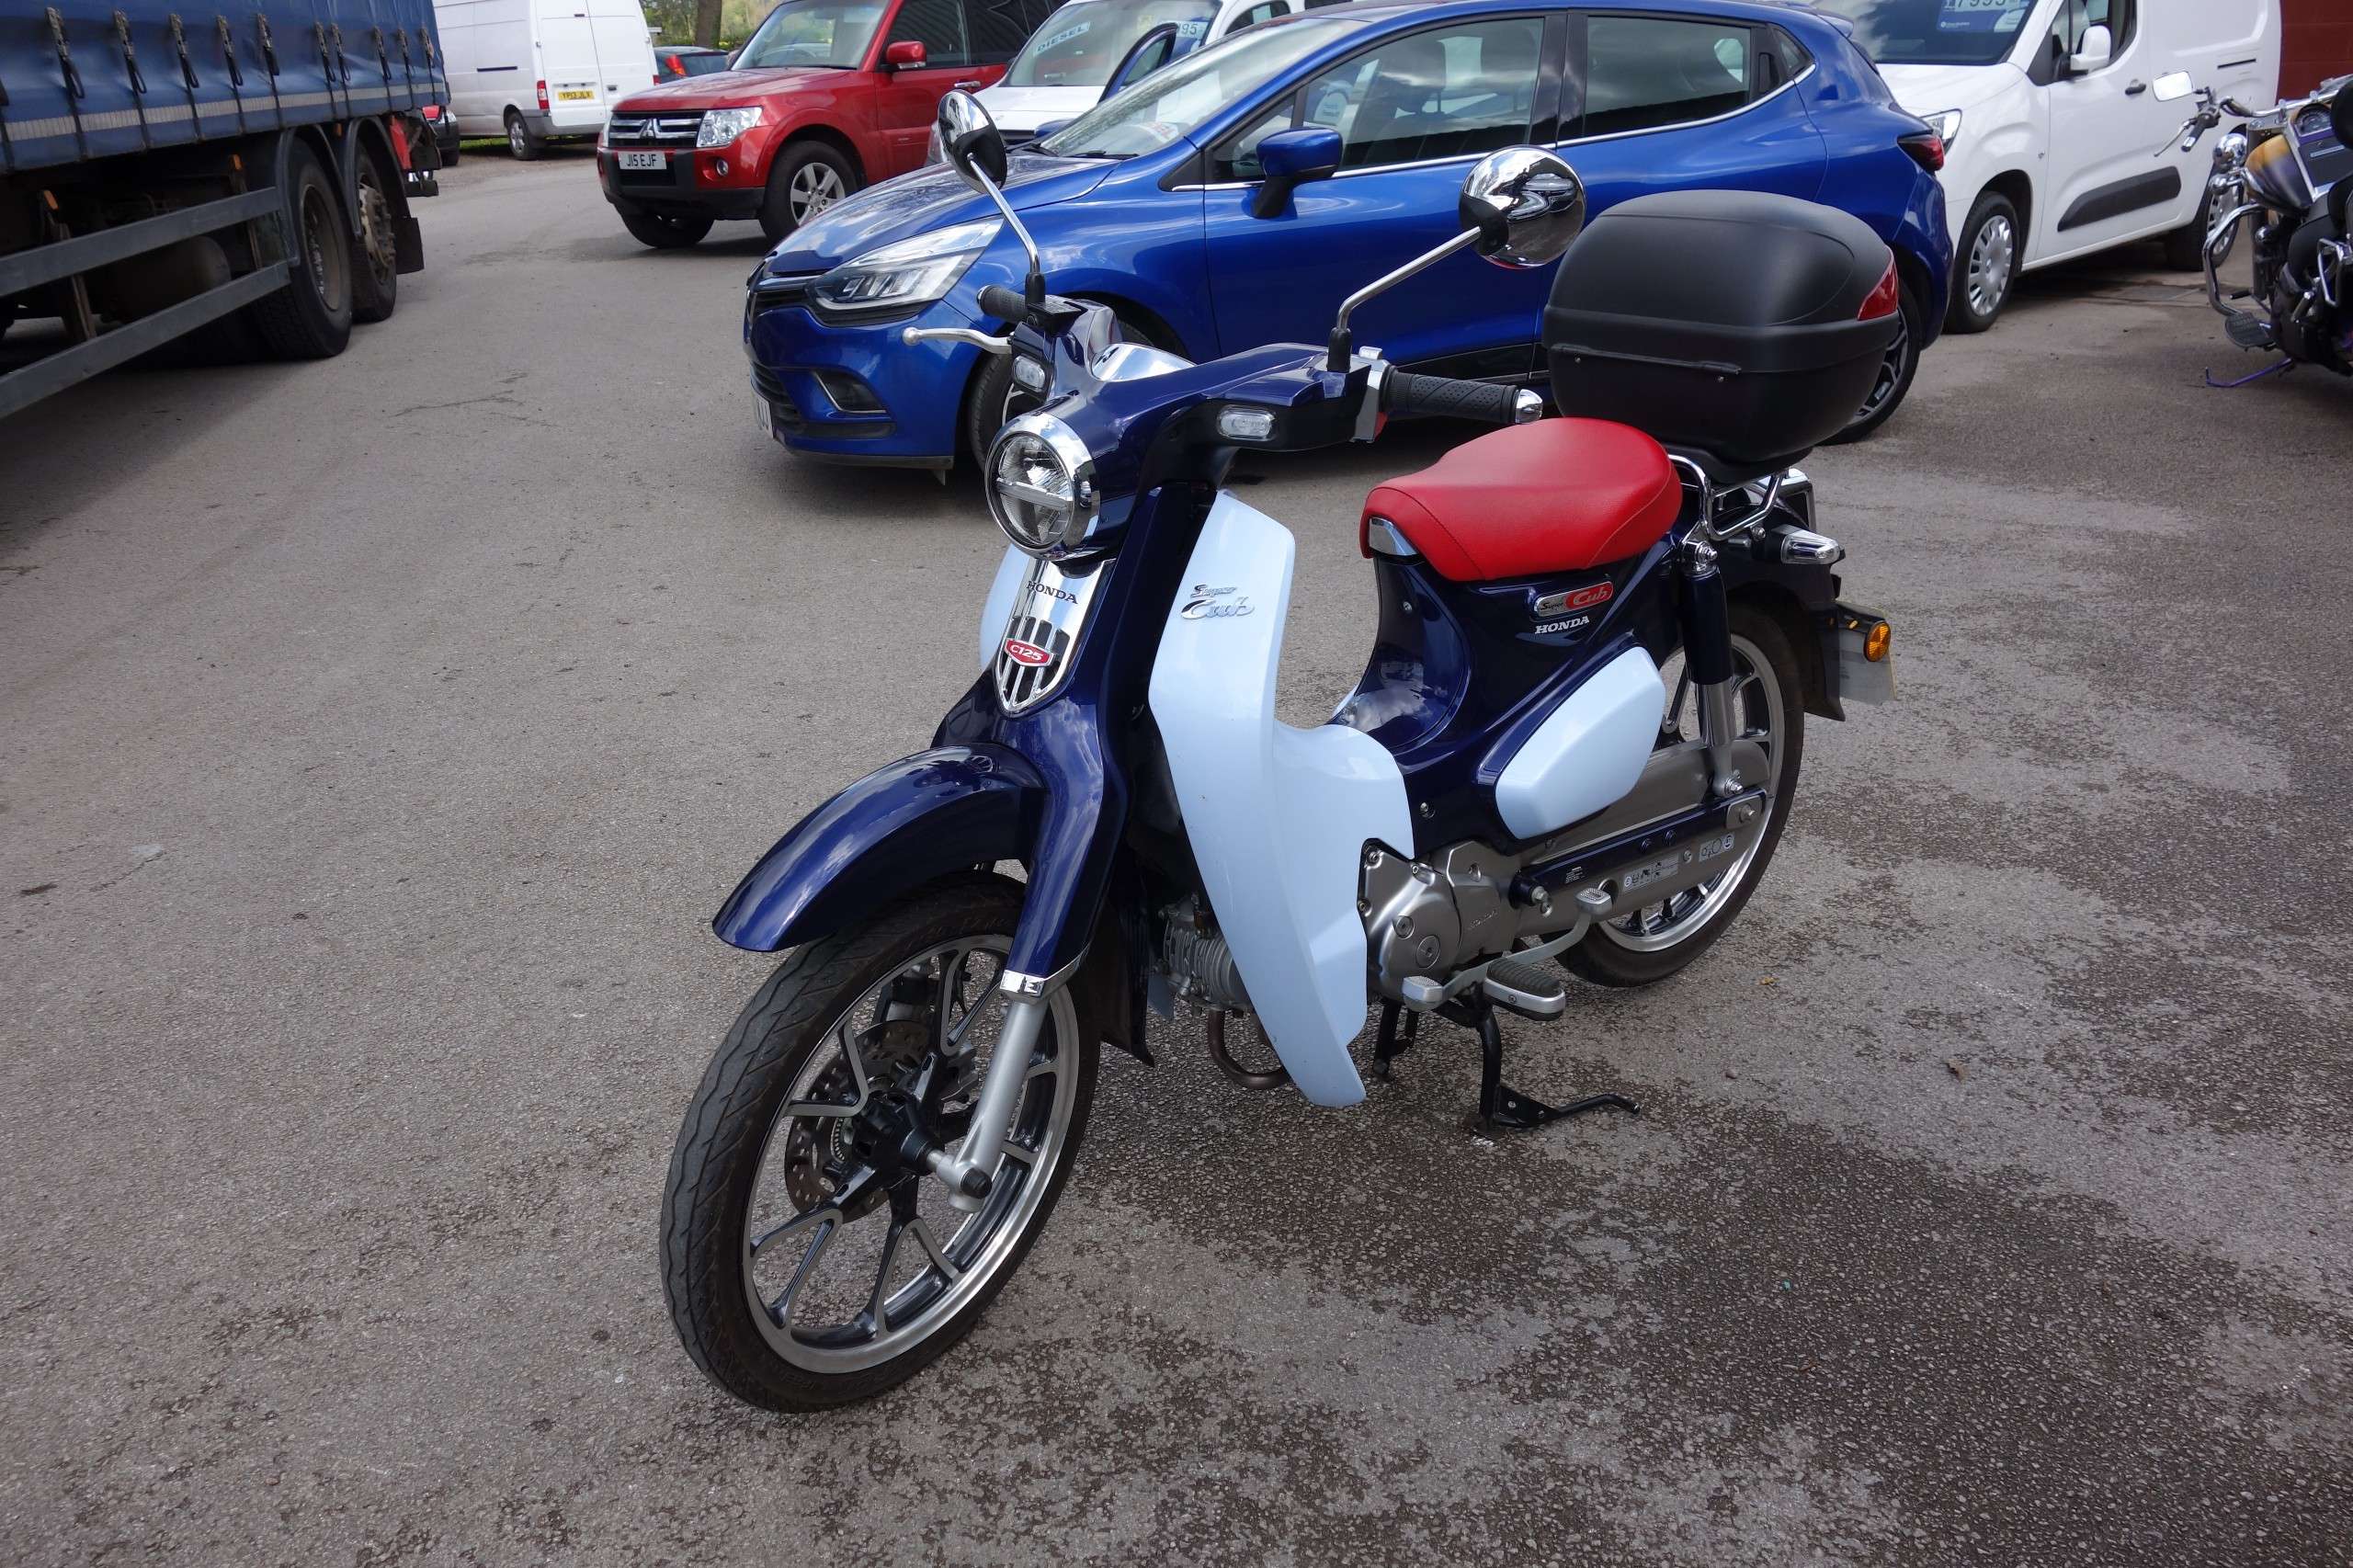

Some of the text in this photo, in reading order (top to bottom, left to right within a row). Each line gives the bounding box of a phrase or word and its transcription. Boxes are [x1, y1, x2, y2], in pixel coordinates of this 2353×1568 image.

[640, 153, 656, 167] EJF
[1026, 580, 1078, 605] HONDA
[1540, 586, 1608, 611] Super Cub
[1534, 615, 1590, 635] HONDA
[1010, 644, 1044, 661] C125
